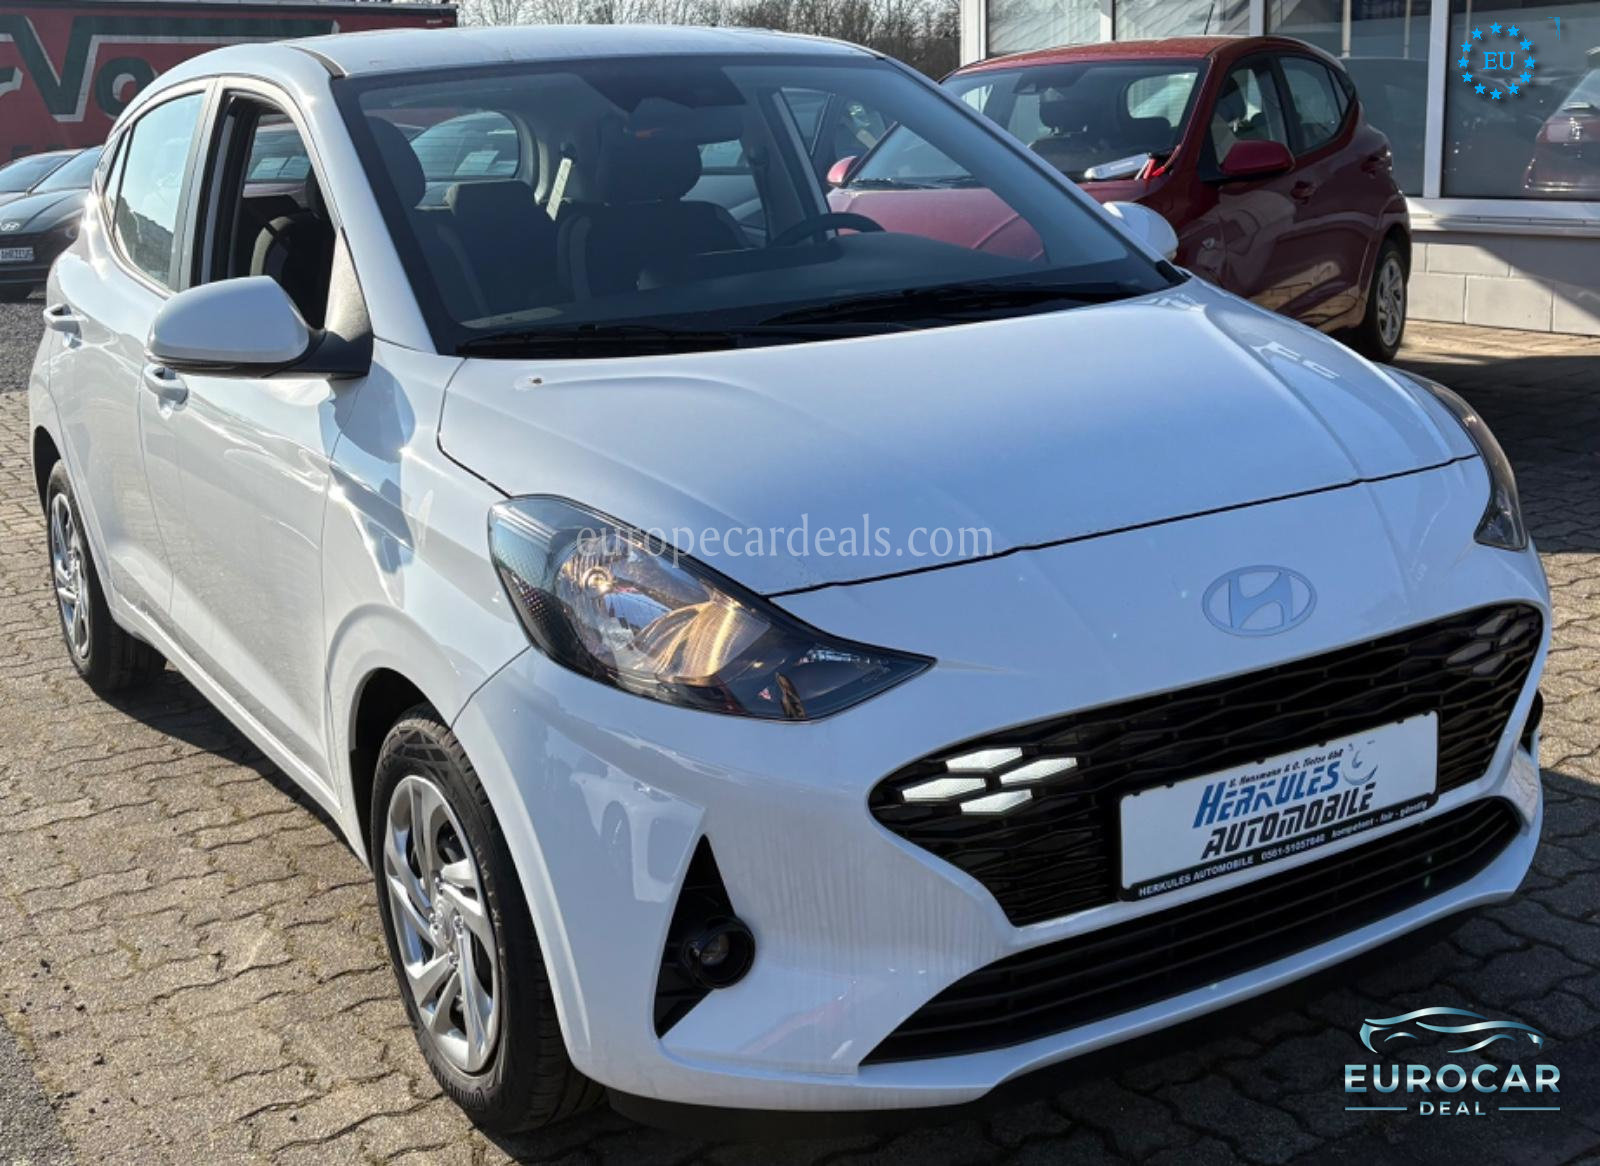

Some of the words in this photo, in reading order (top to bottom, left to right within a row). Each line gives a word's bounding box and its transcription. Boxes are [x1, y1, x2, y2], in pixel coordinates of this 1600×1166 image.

[1193, 760, 1341, 829] HERKULES
[1200, 781, 1377, 861] AUTOMOBILE
[1138, 873, 1192, 898] HERKULES
[1193, 855, 1254, 882] AUTOMOBILE
